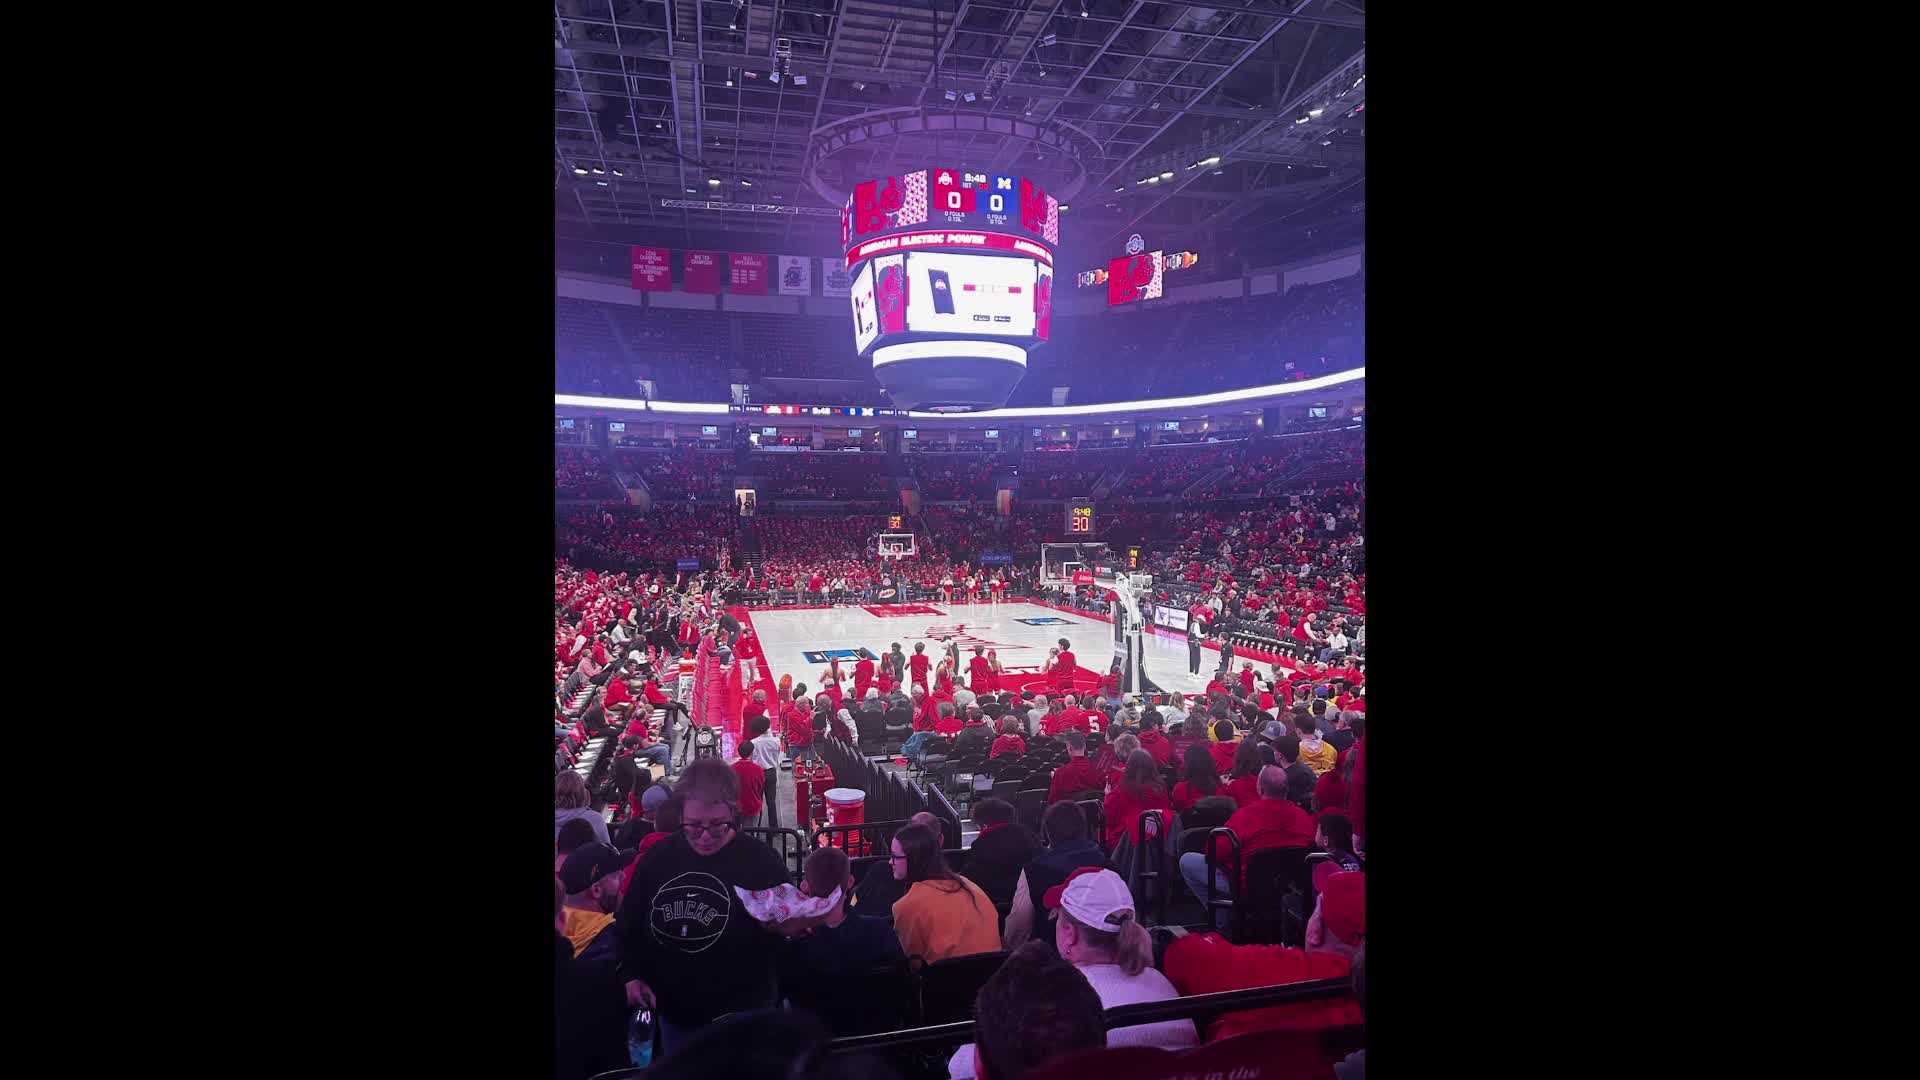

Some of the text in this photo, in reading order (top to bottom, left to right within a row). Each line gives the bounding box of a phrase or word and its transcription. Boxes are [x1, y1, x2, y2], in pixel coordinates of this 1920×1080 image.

[948, 191, 961, 208] 0
[990, 194, 1003, 212] 0
[900, 235, 944, 246] ELECTRIC
[947, 234, 986, 244] POWER
[1074, 508, 1091, 516] 9:48
[890, 521, 900, 529] 30
[1072, 517, 1089, 531] 30
[1088, 716, 1100, 733] 5
[662, 900, 719, 926] BUCKS
